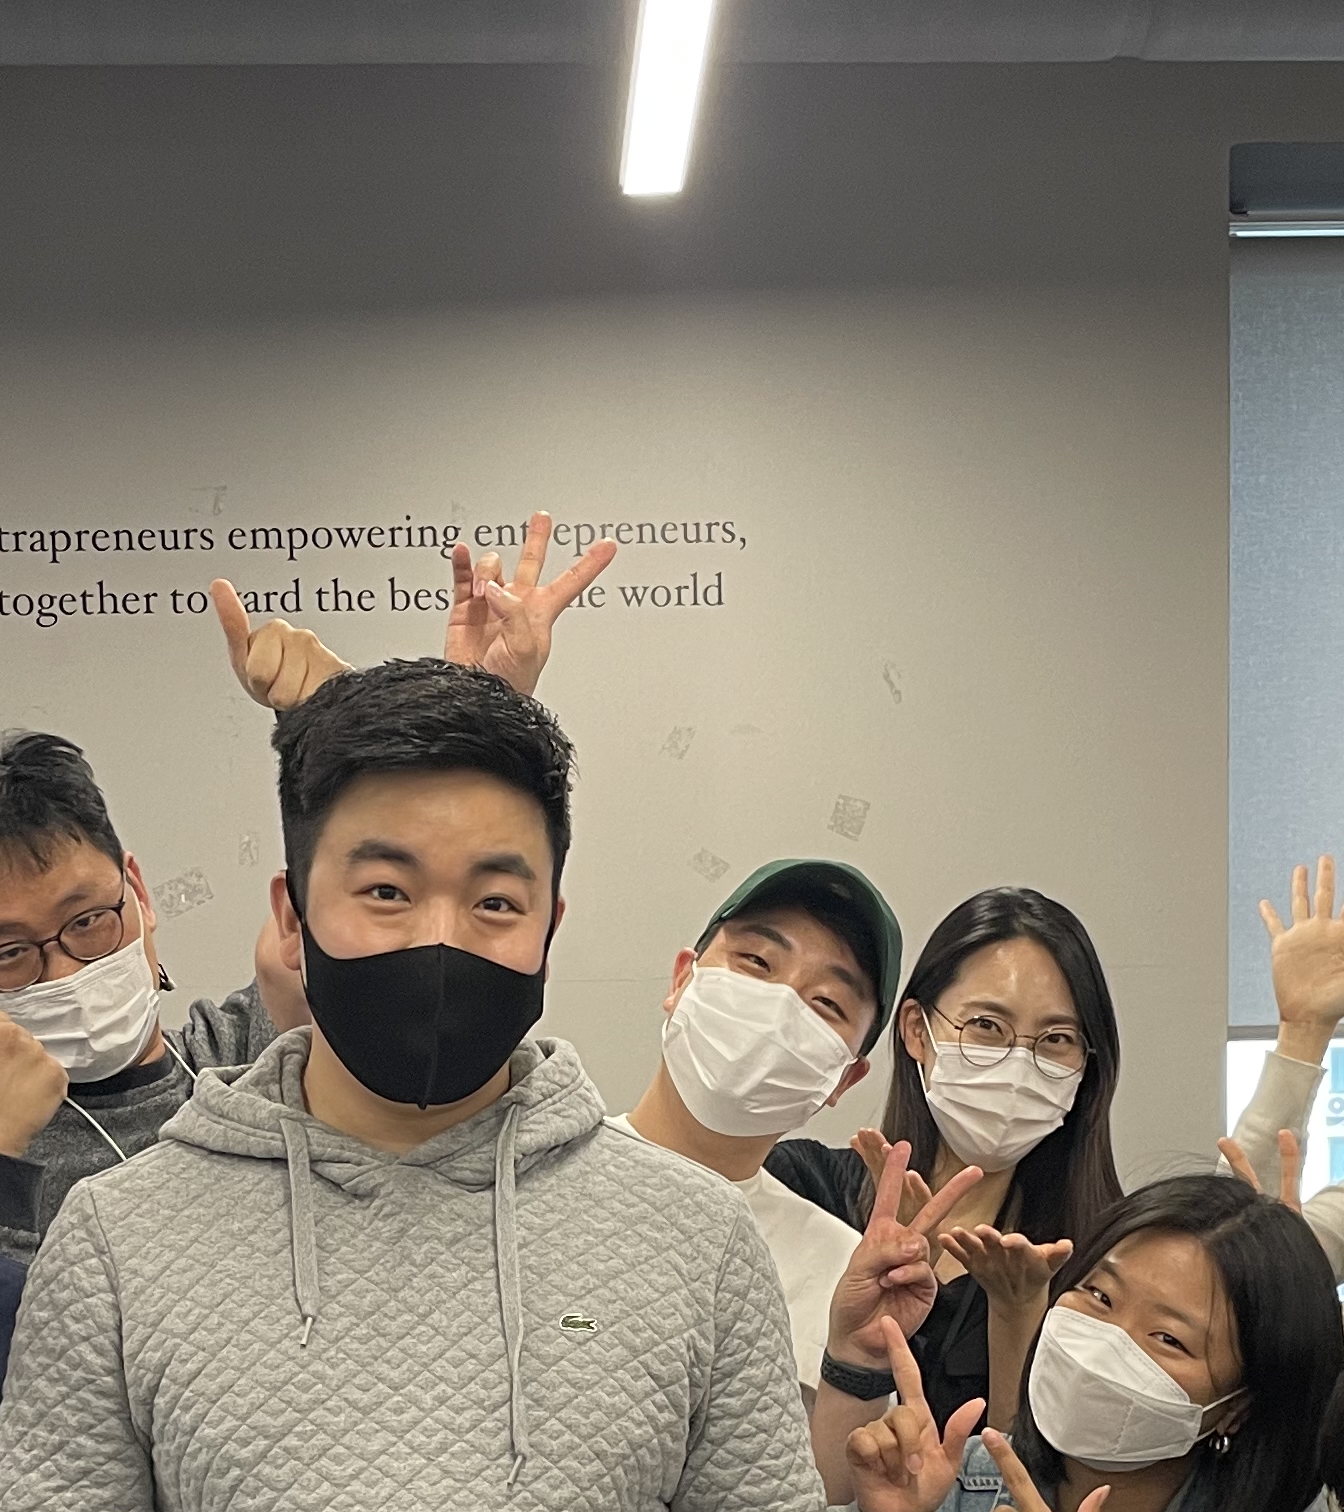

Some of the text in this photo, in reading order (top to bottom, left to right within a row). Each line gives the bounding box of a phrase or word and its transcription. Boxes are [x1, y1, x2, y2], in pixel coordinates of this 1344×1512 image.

[227, 515, 462, 561] empowering
[474, 518, 748, 558] entepreneurs,
[170, 578, 304, 615] toard
[315, 577, 377, 613] the
[388, 576, 454, 612] bes
[618, 571, 726, 609] world
